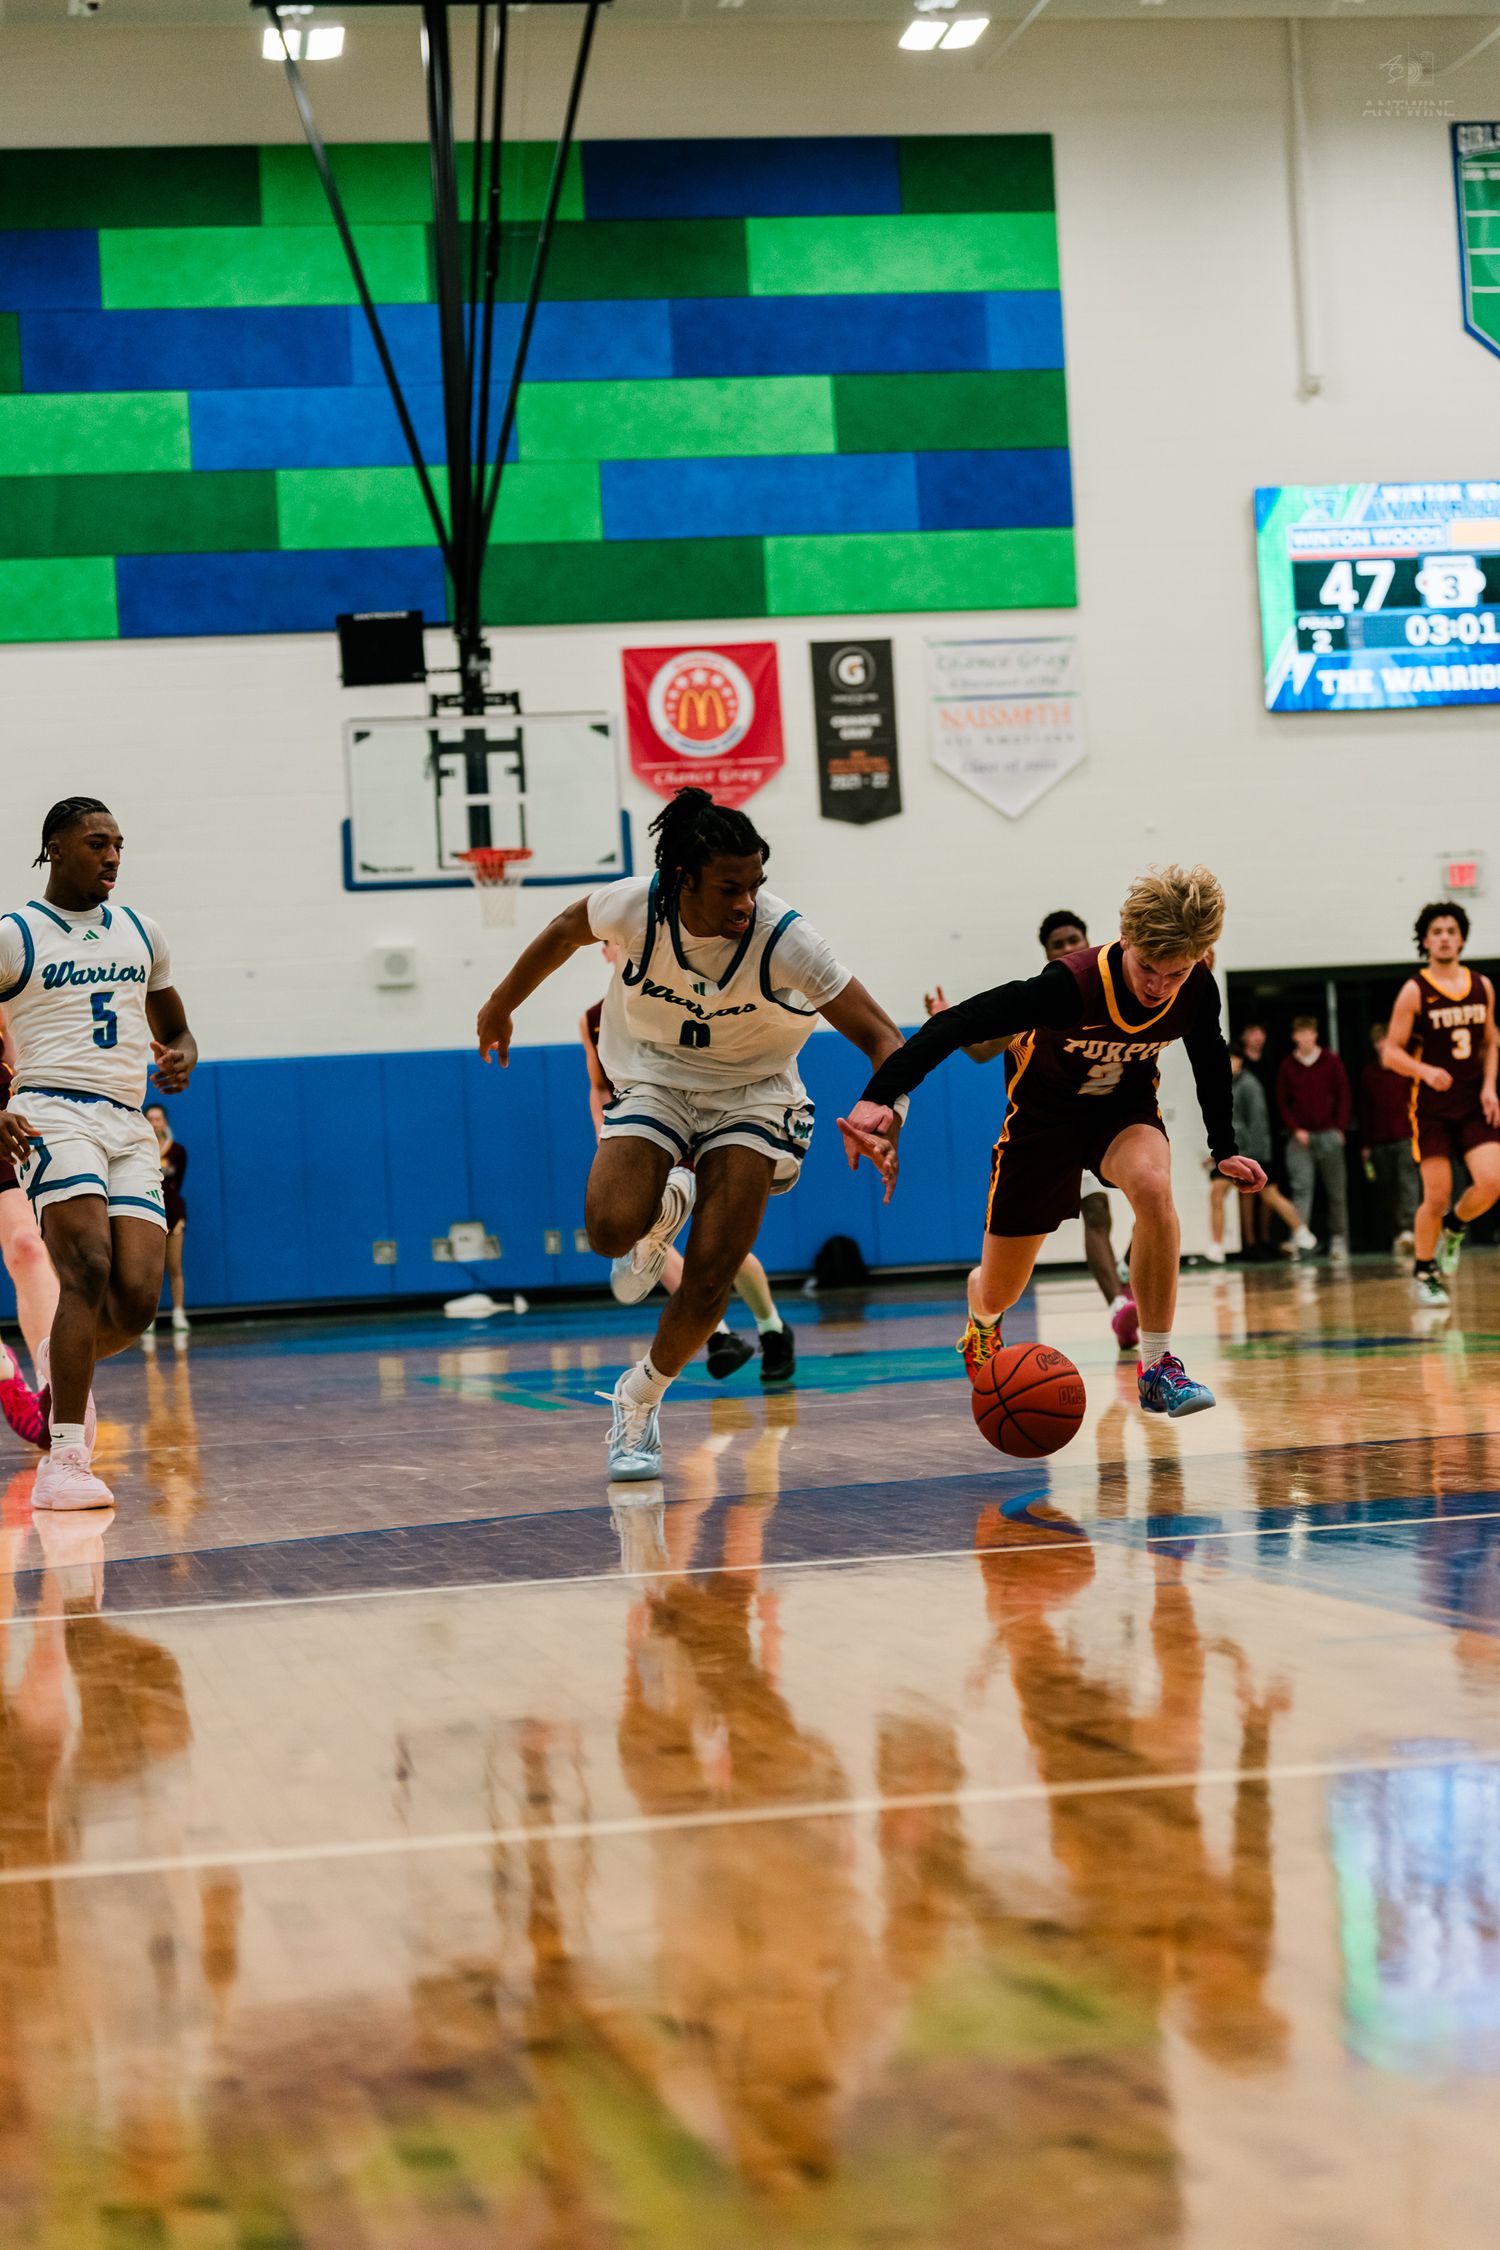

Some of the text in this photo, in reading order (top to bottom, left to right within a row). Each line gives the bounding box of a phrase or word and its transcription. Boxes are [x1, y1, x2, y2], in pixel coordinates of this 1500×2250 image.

[1319, 560, 1396, 613] 47
[1443, 575, 1460, 601] 3
[1311, 630, 1334, 654] 2
[1316, 669, 1374, 695] THE
[938, 703, 1073, 731] NAISMITH
[42, 960, 146, 990] Warriors
[90, 991, 117, 1049] 5
[1451, 1028, 1472, 1059] 3
[1077, 1061, 1124, 1096] 2
